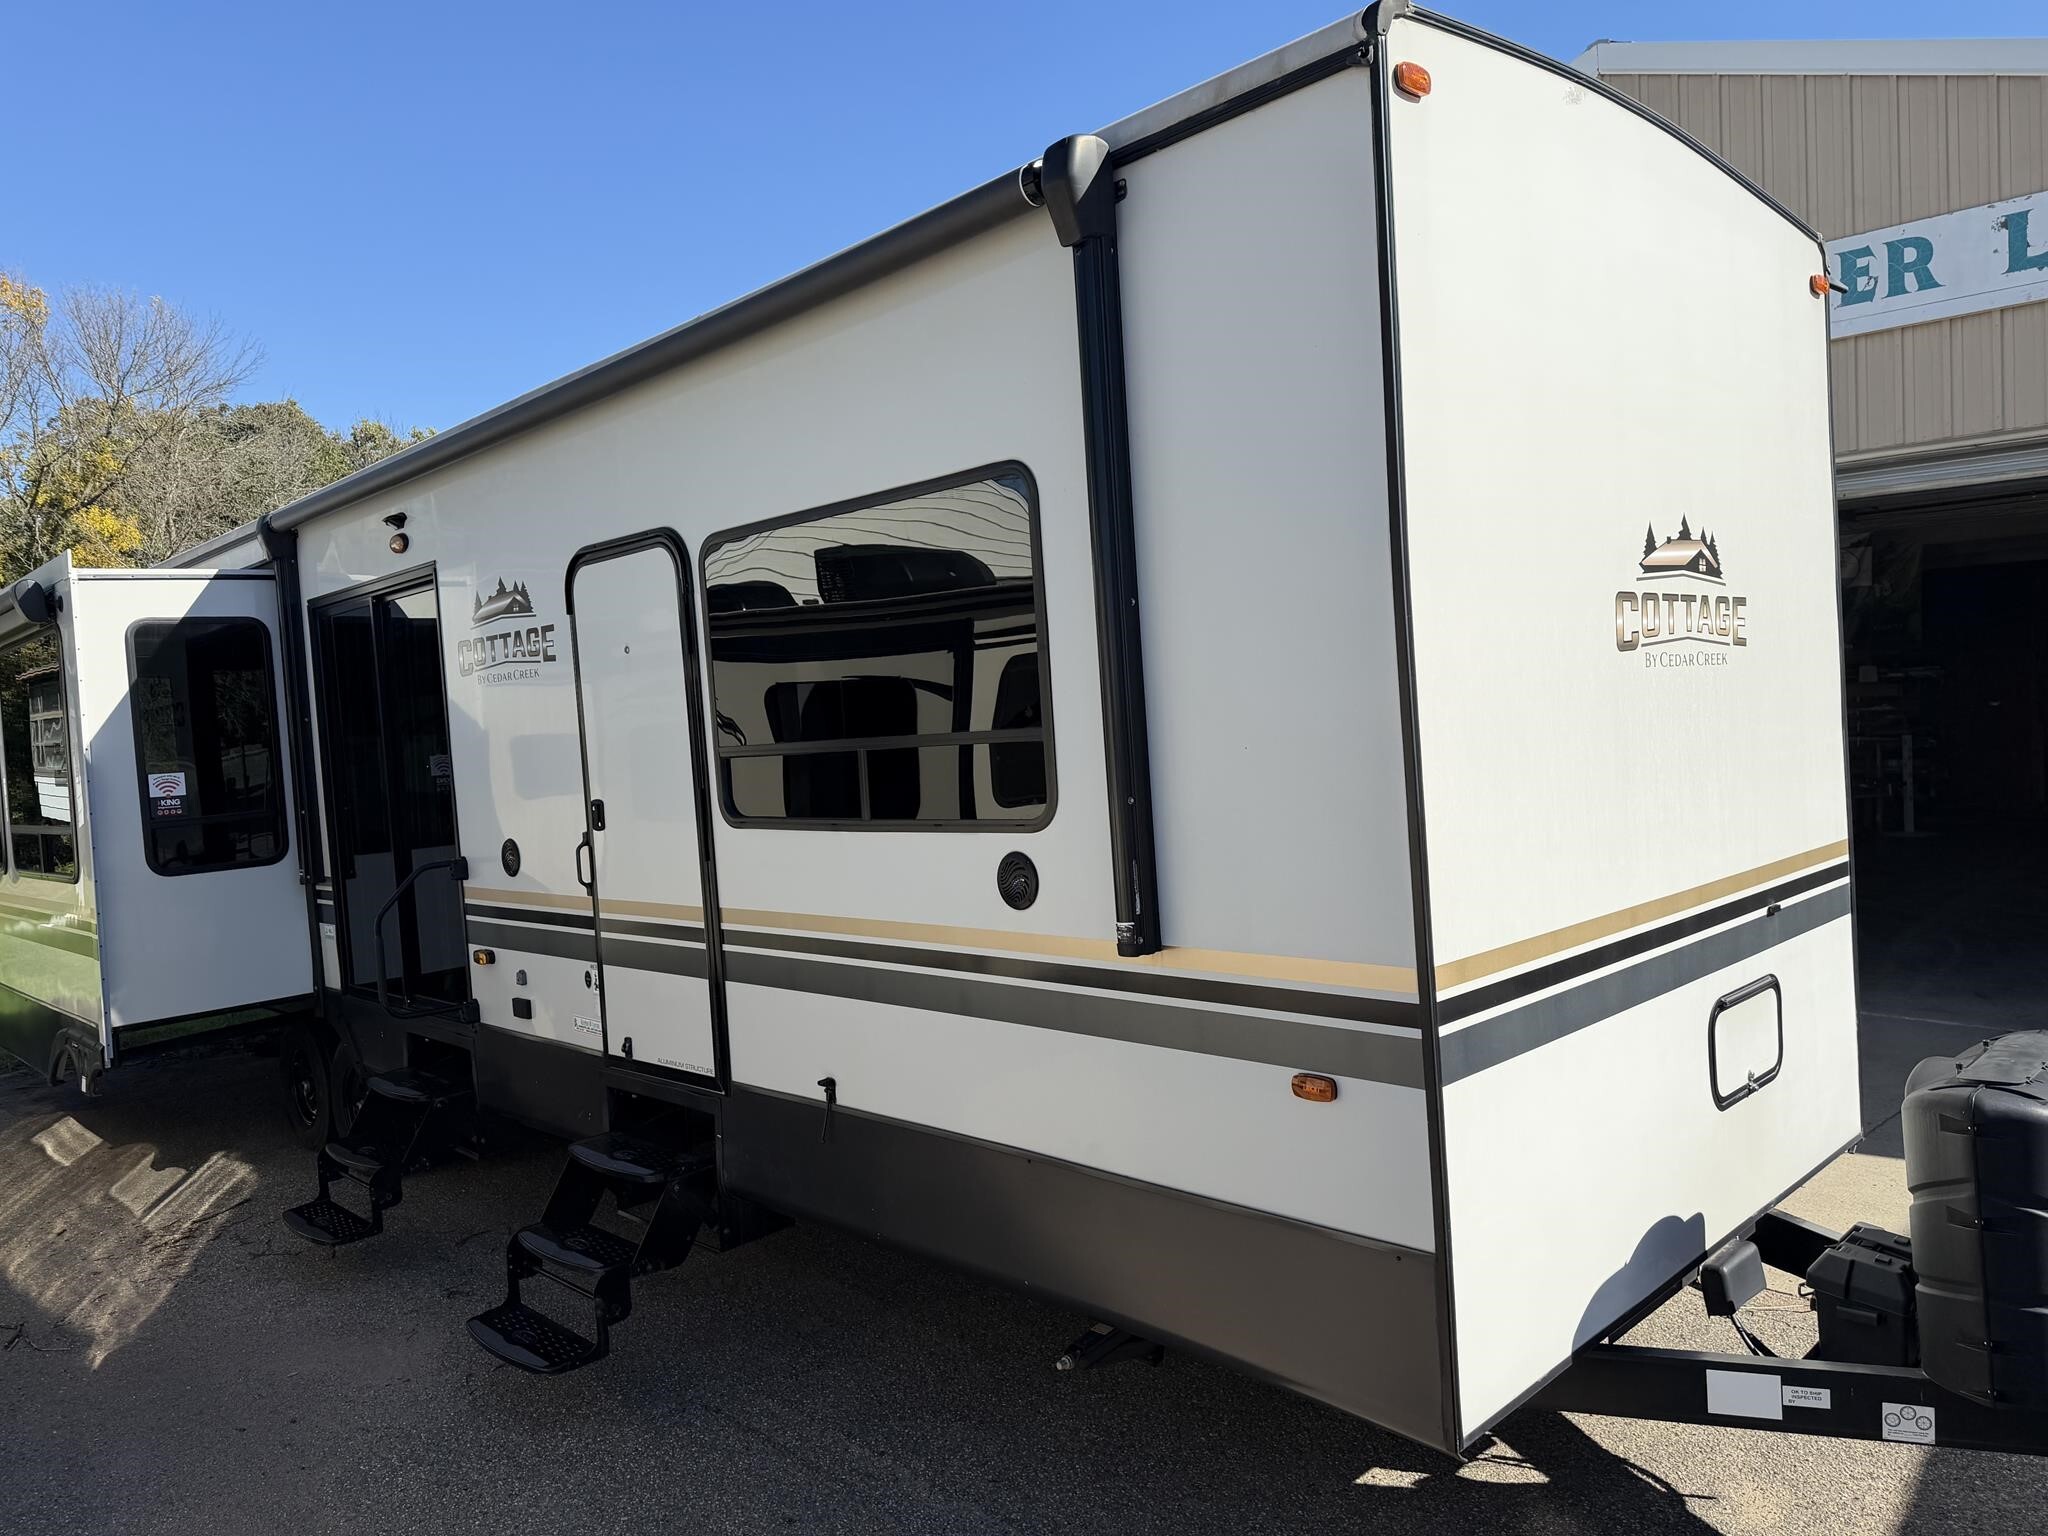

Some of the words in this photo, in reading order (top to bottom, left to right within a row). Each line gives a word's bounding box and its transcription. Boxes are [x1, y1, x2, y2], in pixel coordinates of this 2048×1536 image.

[1615, 591, 1747, 652] COTTAGE
[458, 624, 556, 677] COTTAGE
[1645, 652, 1658, 668] BY
[1659, 651, 1695, 668] CEDAR
[1696, 651, 1728, 666] CREEK
[486, 671, 512, 684] CEDAR
[513, 668, 540, 680] CREEK
[657, 1057, 684, 1069] ALUMINUM
[684, 1062, 714, 1075] STRUCTURE
